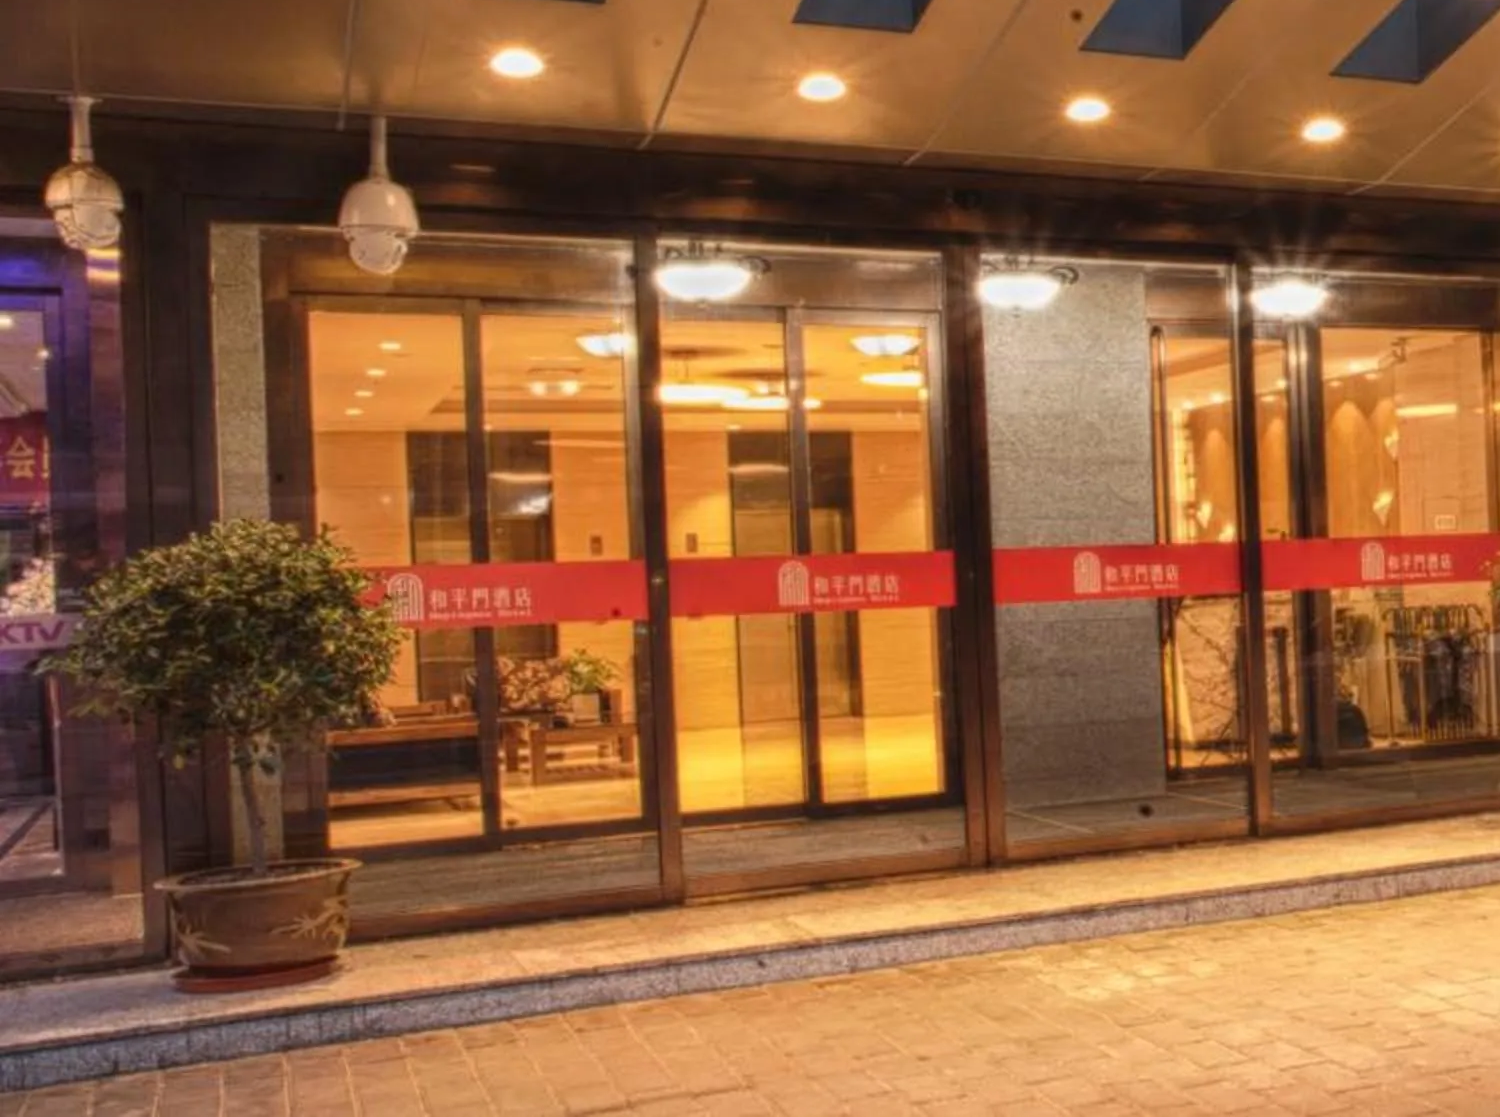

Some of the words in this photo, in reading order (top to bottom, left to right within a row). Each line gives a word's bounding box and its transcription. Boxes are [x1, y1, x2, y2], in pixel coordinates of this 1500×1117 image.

[429, 586, 532, 610] 和平門酒店
